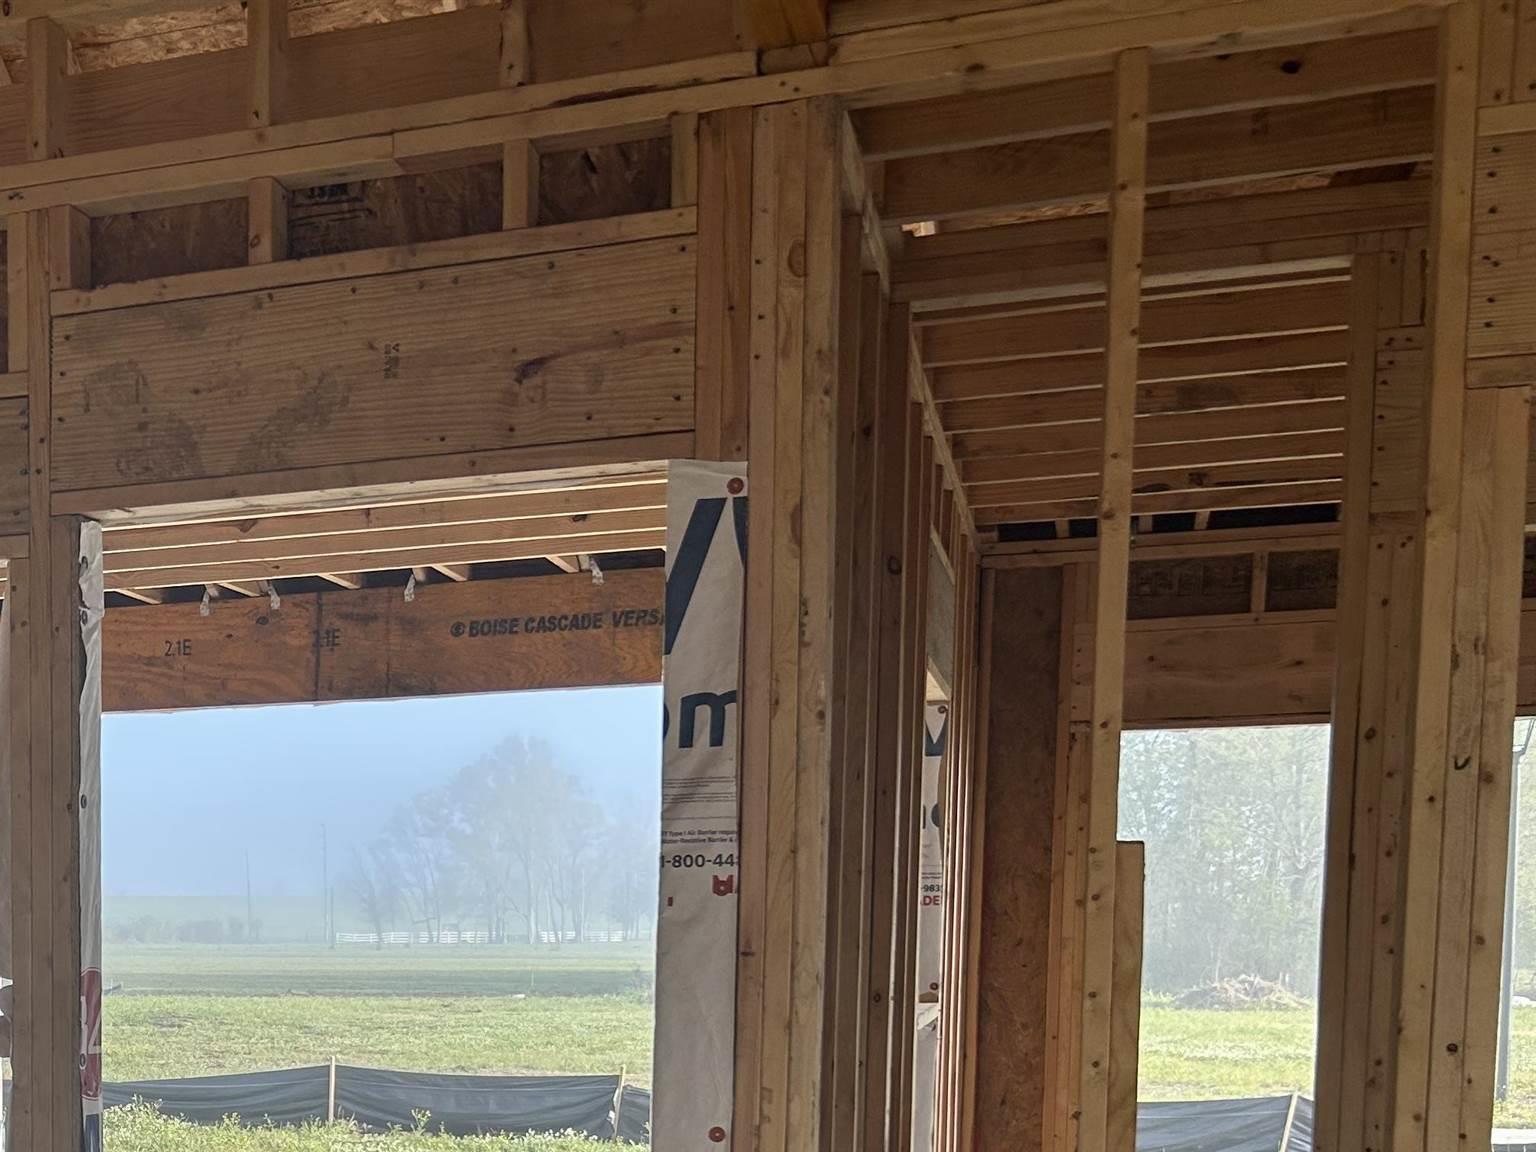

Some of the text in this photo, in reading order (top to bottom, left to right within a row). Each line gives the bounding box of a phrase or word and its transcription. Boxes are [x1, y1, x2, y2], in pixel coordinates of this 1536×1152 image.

[468, 618, 520, 637] BOISE
[524, 612, 603, 634] CASCADE
[164, 639, 193, 657] 2.1E
[661, 853, 739, 869] 1-800-44
